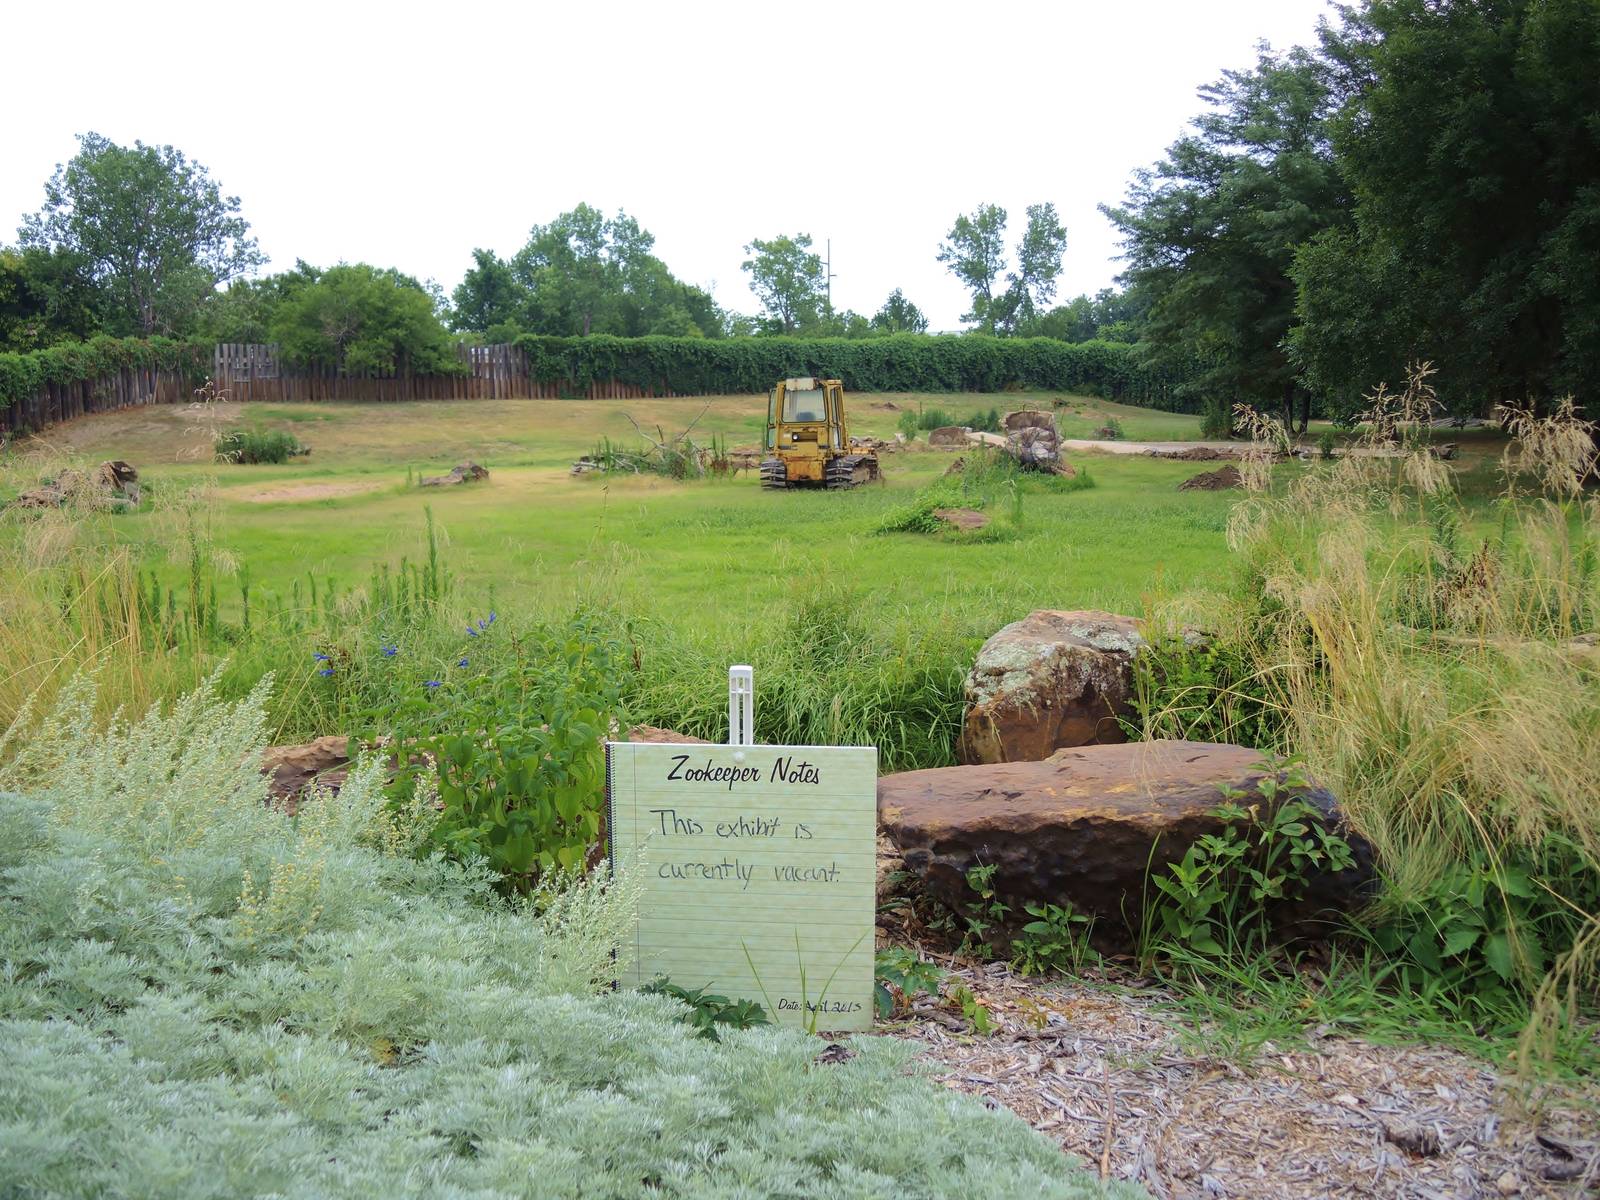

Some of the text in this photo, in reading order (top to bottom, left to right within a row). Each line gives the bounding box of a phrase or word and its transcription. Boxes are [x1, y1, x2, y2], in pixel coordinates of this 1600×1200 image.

[667, 755, 819, 791] Zookeeper Notes
[650, 809, 813, 840] This exhibit is
[658, 857, 841, 890] currently vacant.
[778, 998, 802, 1011] Date:
